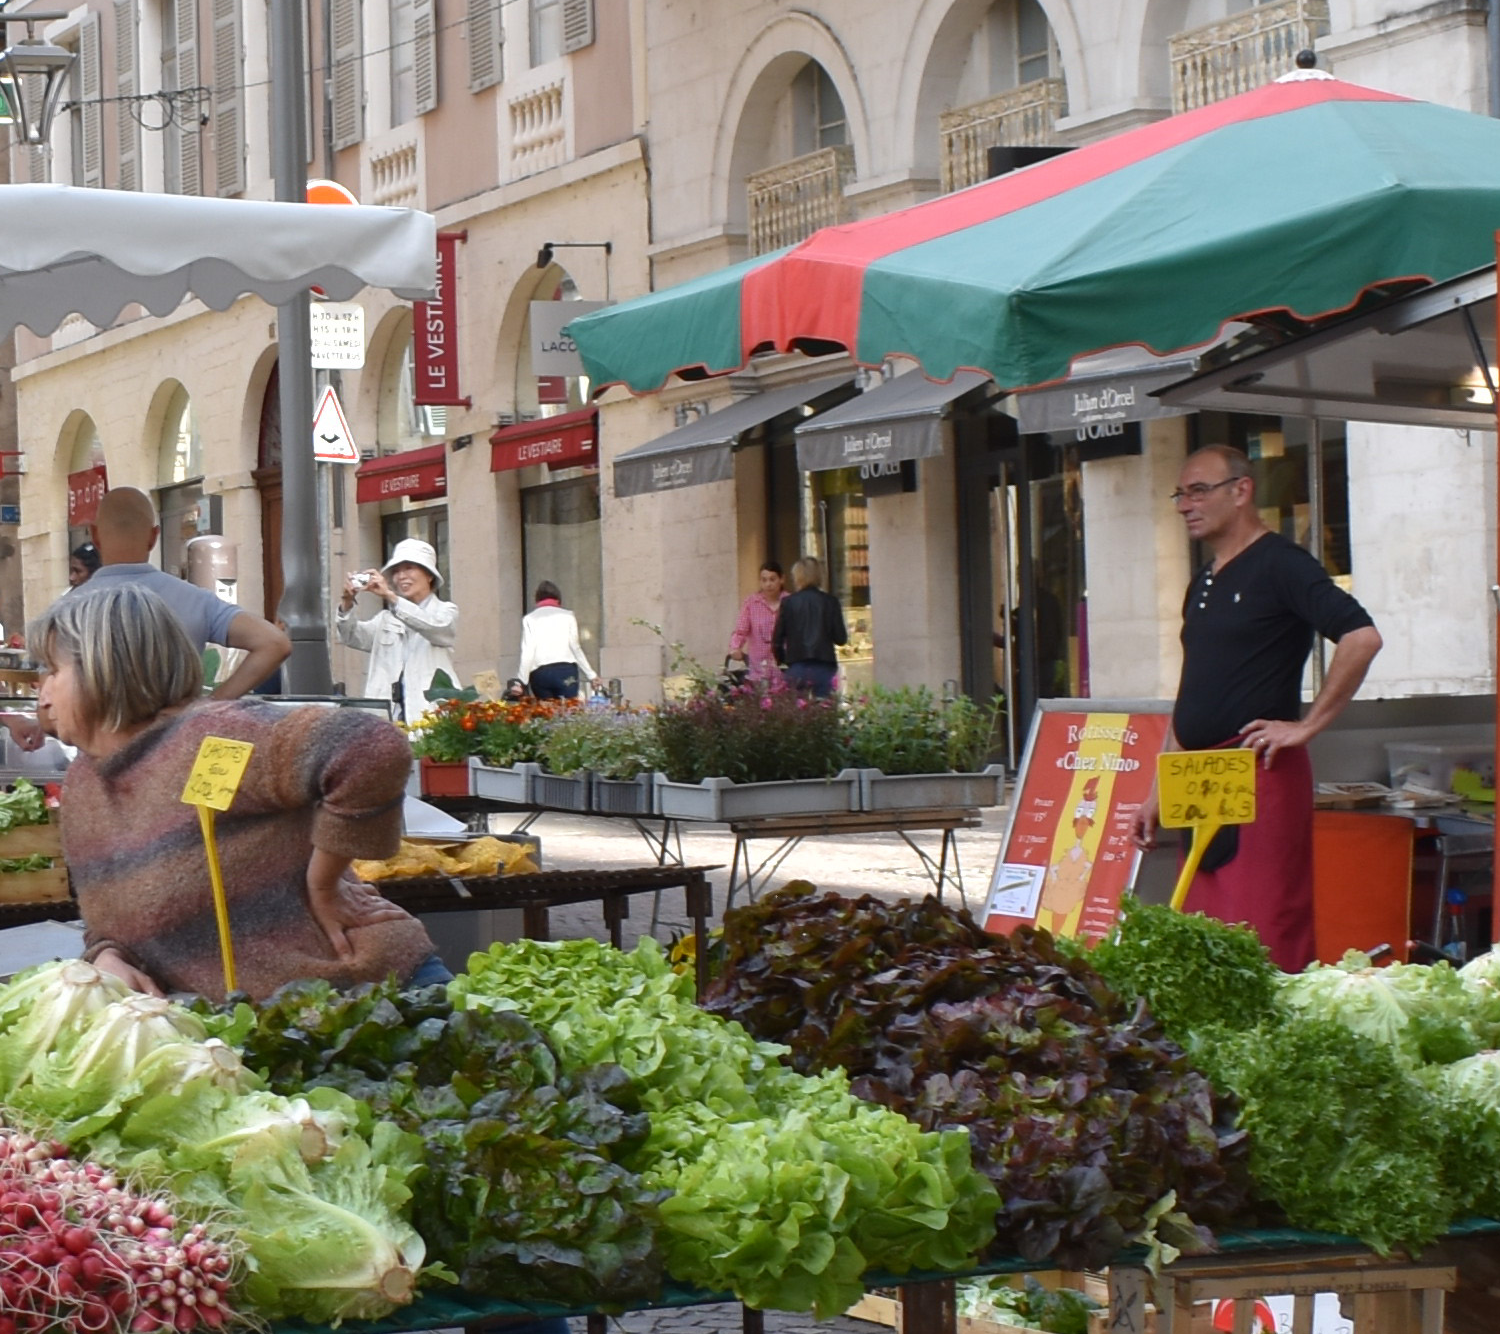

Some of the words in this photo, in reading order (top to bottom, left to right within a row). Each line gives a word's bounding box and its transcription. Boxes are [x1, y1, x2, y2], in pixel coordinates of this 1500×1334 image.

[541, 341, 578, 352] LACO
[429, 365, 446, 389] LE
[1056, 750, 1097, 771] «Chez
[1100, 752, 1141, 772] Nino»
[1170, 756, 1250, 777] SALADES
